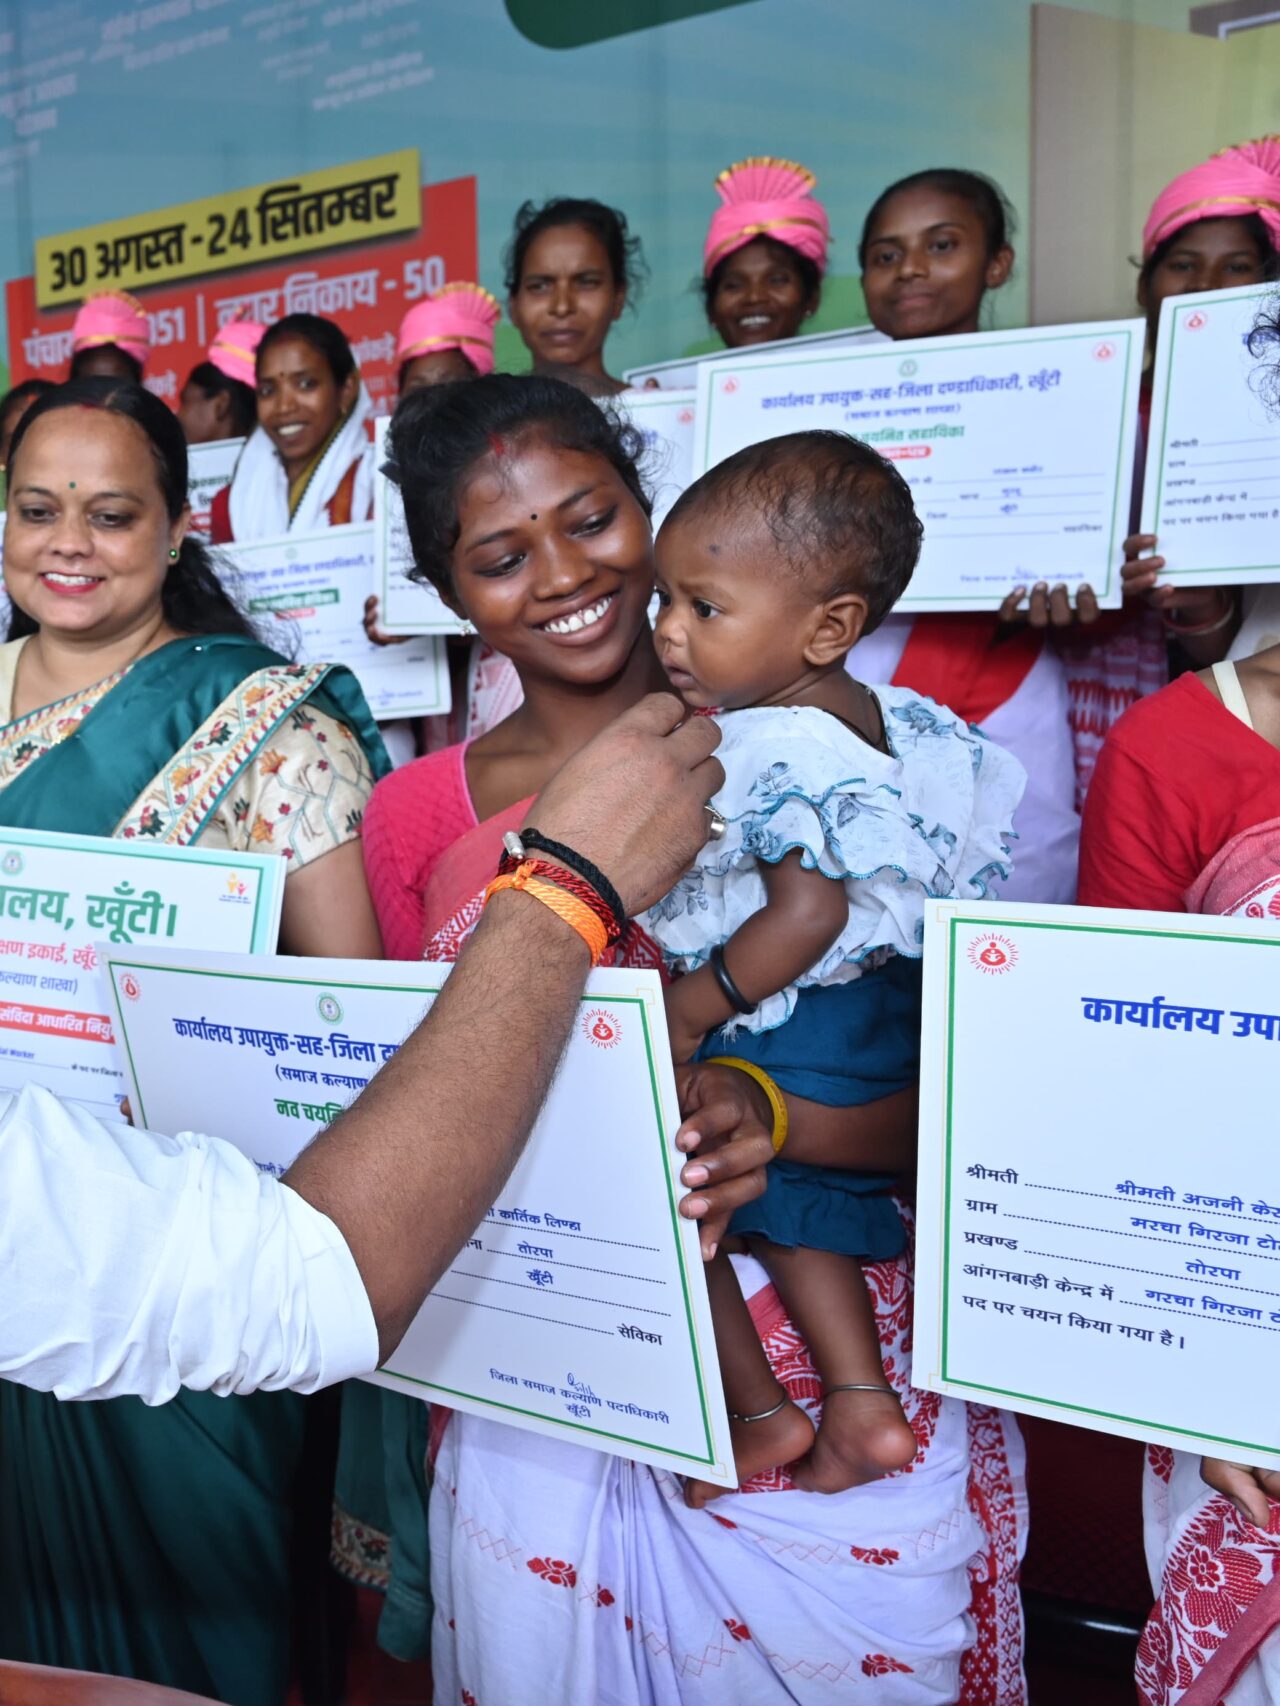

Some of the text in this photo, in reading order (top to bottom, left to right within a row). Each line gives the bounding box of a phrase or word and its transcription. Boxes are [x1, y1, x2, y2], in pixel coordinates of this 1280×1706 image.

[51, 246, 86, 292] 30
[96, 223, 186, 280] अगस्त
[208, 207, 251, 257] 24
[257, 172, 400, 247] सितम्बर
[404, 256, 446, 300] 50
[761, 390, 815, 410] कार्यालय
[86, 879, 179, 944] खूँटी।
[27, 936, 69, 966] इकाई,
[40, 973, 80, 996] शाखा)
[0, 1004, 35, 1025] संविदा
[37, 1011, 84, 1032] आधारित
[172, 1016, 233, 1044] कार्यालय
[1080, 996, 1226, 1035] कार्यालय
[275, 1063, 318, 1085] (समाज
[274, 1098, 300, 1120] नव
[965, 1163, 1019, 1185] श्रीमती
[1115, 1179, 1176, 1202] श्रीमती
[1182, 1193, 1245, 1213] अजनी
[498, 1207, 542, 1225] कार्तिक
[965, 1198, 998, 1216] ग्राम
[1130, 1216, 1182, 1236] मरचा
[1188, 1221, 1250, 1247] गिरजा
[517, 1241, 555, 1259] तोरपा
[963, 1231, 1242, 1281] प्रखण्ड तोरपा
[526, 1268, 554, 1287] खूँटी
[962, 1263, 1049, 1291] आंगनबाड़ी
[1054, 1276, 1093, 1299] केन्द्र
[1099, 1284, 1114, 1302] में
[1201, 1295, 1263, 1320] गिरजा
[962, 1295, 986, 1312] पद
[992, 1300, 1015, 1317] पर
[1020, 1306, 1062, 1326] चयन
[1068, 1312, 1112, 1335] किया
[1117, 1324, 1154, 1343] गया
[616, 1322, 664, 1347] सेविका
[489, 1367, 519, 1386] जिला
[522, 1378, 557, 1397] समाज
[560, 1388, 602, 1408] कल्याण
[606, 1399, 671, 1425] पदाधिकारी
[565, 1402, 592, 1419] खूँटी
